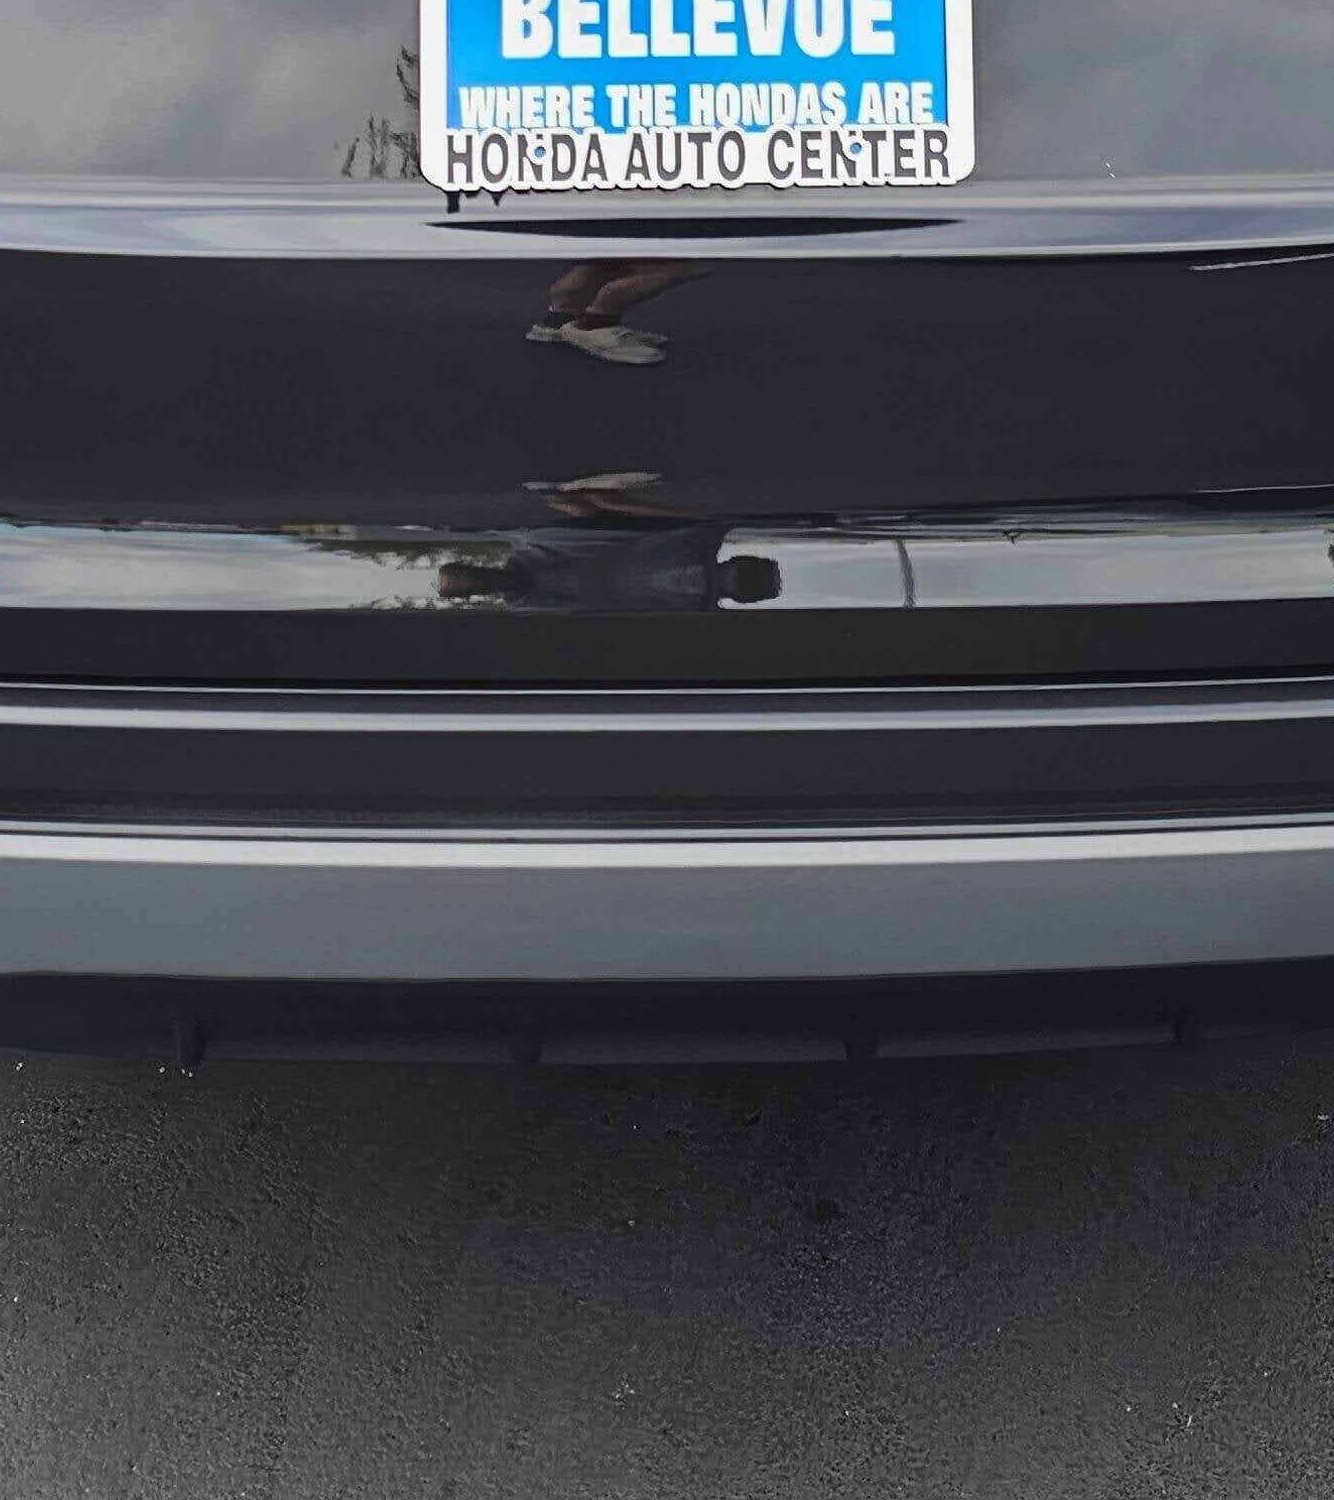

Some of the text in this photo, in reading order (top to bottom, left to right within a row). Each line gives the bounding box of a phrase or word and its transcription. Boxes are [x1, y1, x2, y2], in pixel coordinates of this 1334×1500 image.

[459, 81, 934, 128] WHERE THE HONDAS ARE
[446, 129, 951, 185] HONDA AUTO CENTER
